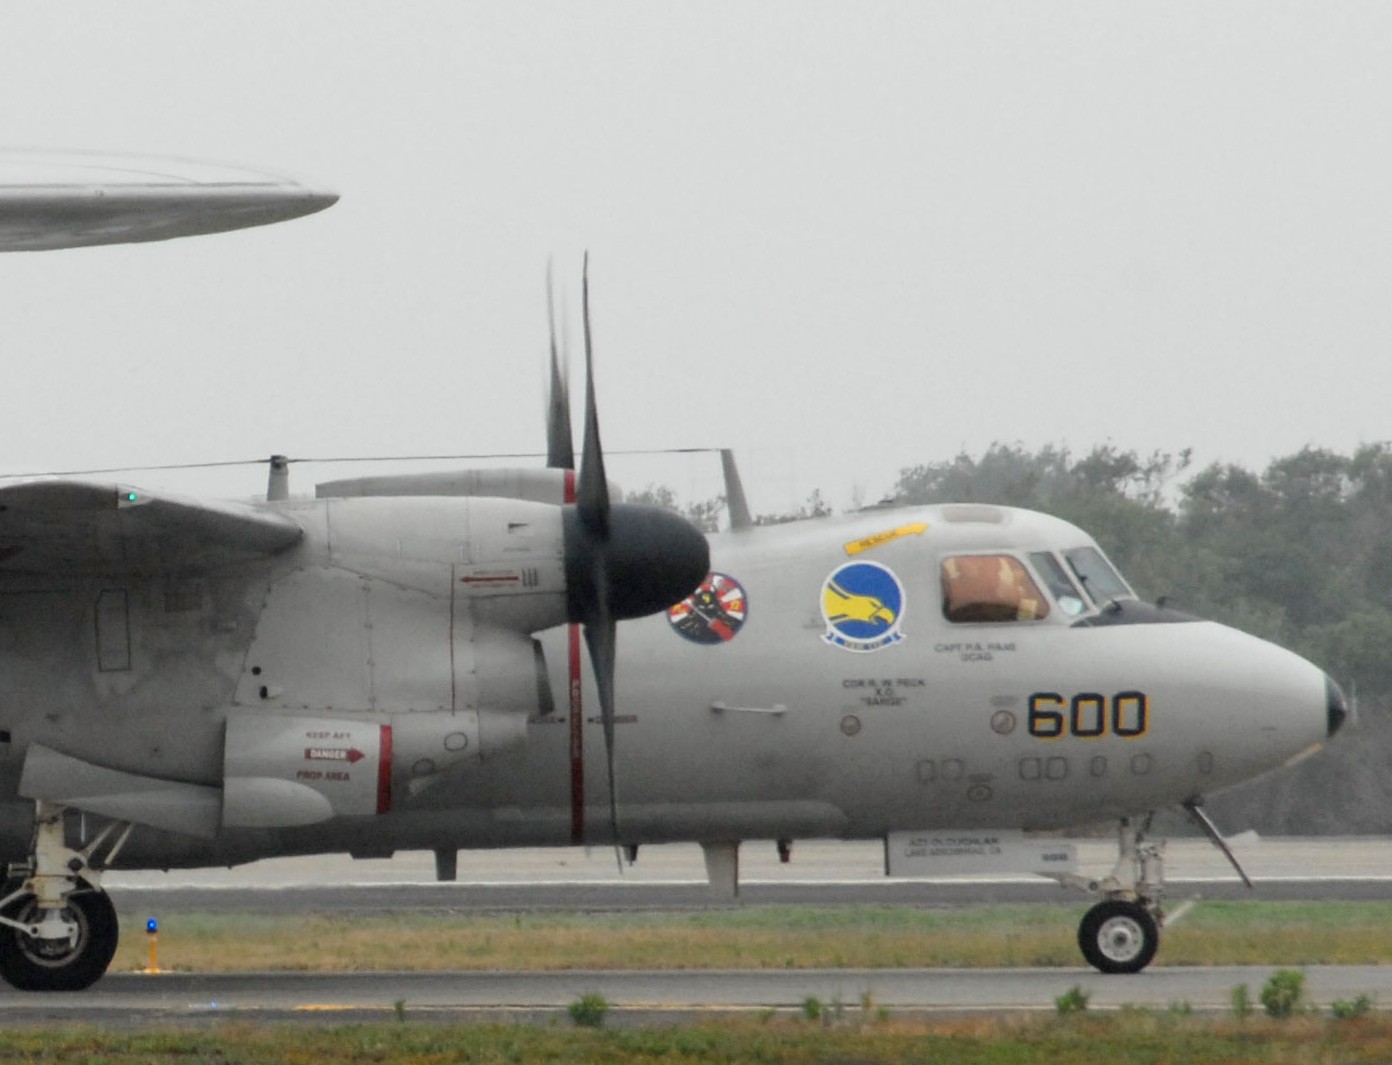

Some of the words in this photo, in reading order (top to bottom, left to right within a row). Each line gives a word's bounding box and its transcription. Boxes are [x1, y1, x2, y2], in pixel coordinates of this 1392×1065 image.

[1028, 691, 1152, 742] 600
[310, 749, 347, 759] DANGER
[296, 770, 323, 780] PROP
[326, 771, 351, 781] AREA
